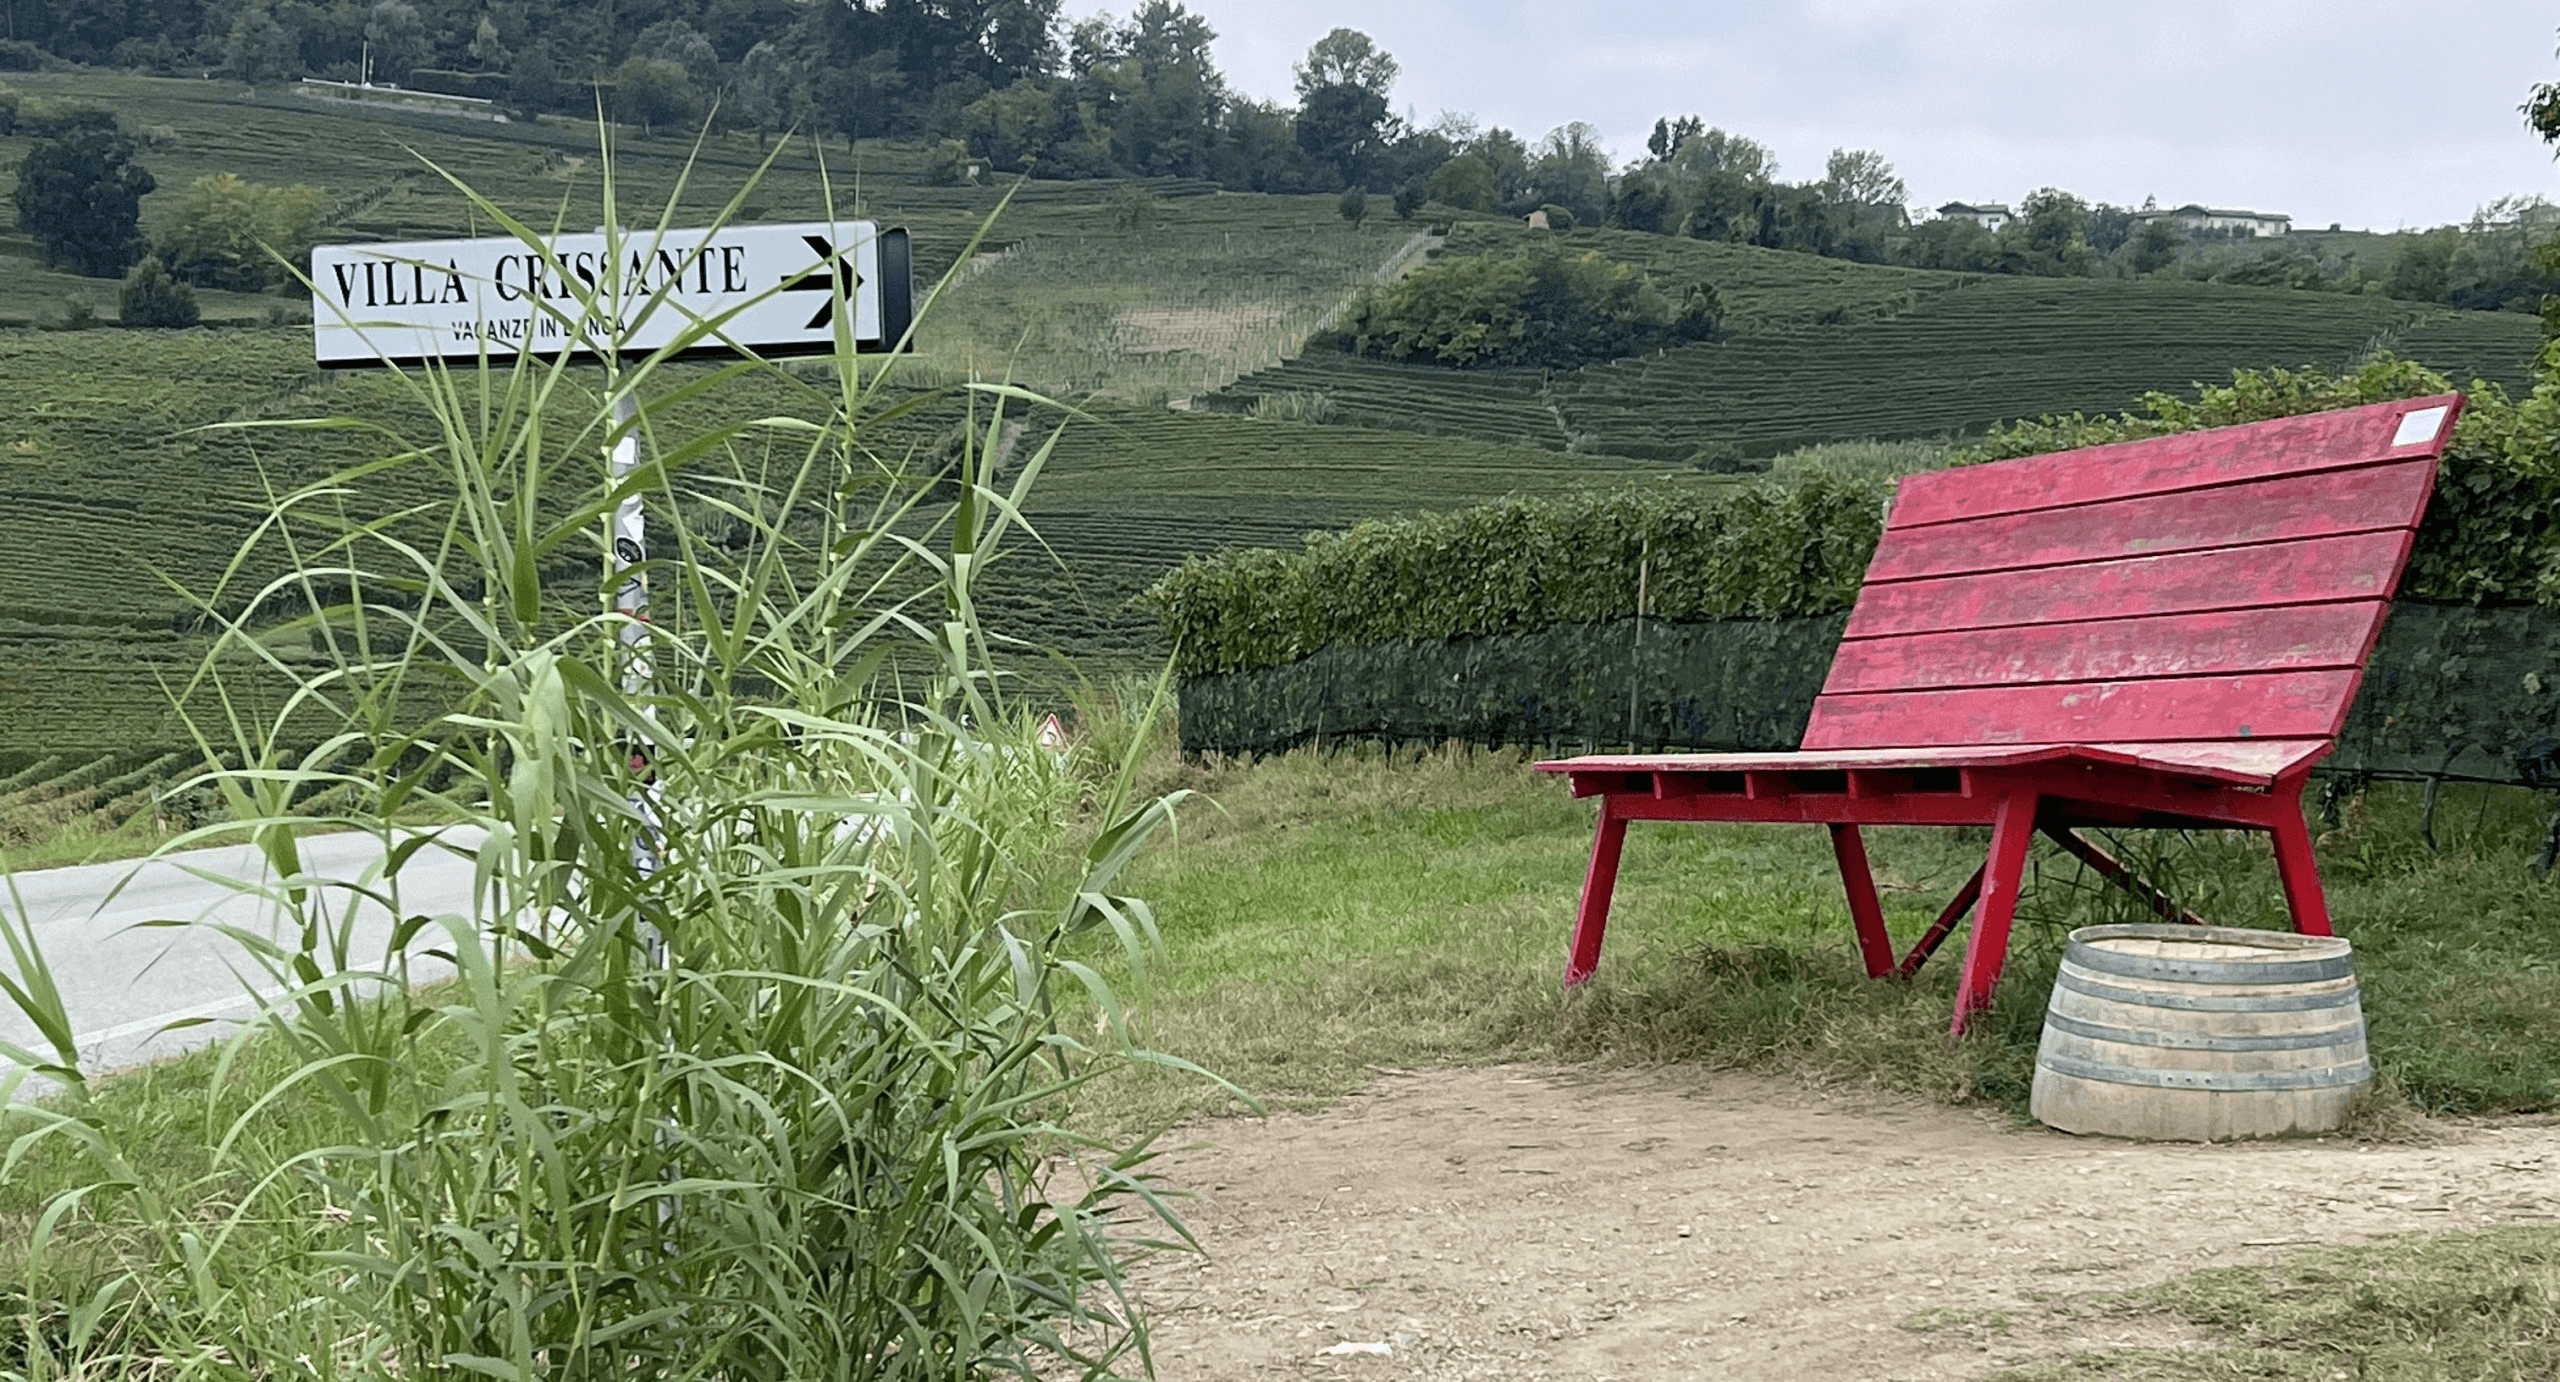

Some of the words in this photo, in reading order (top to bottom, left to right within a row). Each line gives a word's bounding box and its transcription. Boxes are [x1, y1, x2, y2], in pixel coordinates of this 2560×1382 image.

[332, 257, 469, 309] VILLA
[540, 317, 557, 338] IN
[563, 315, 627, 338] LNA
